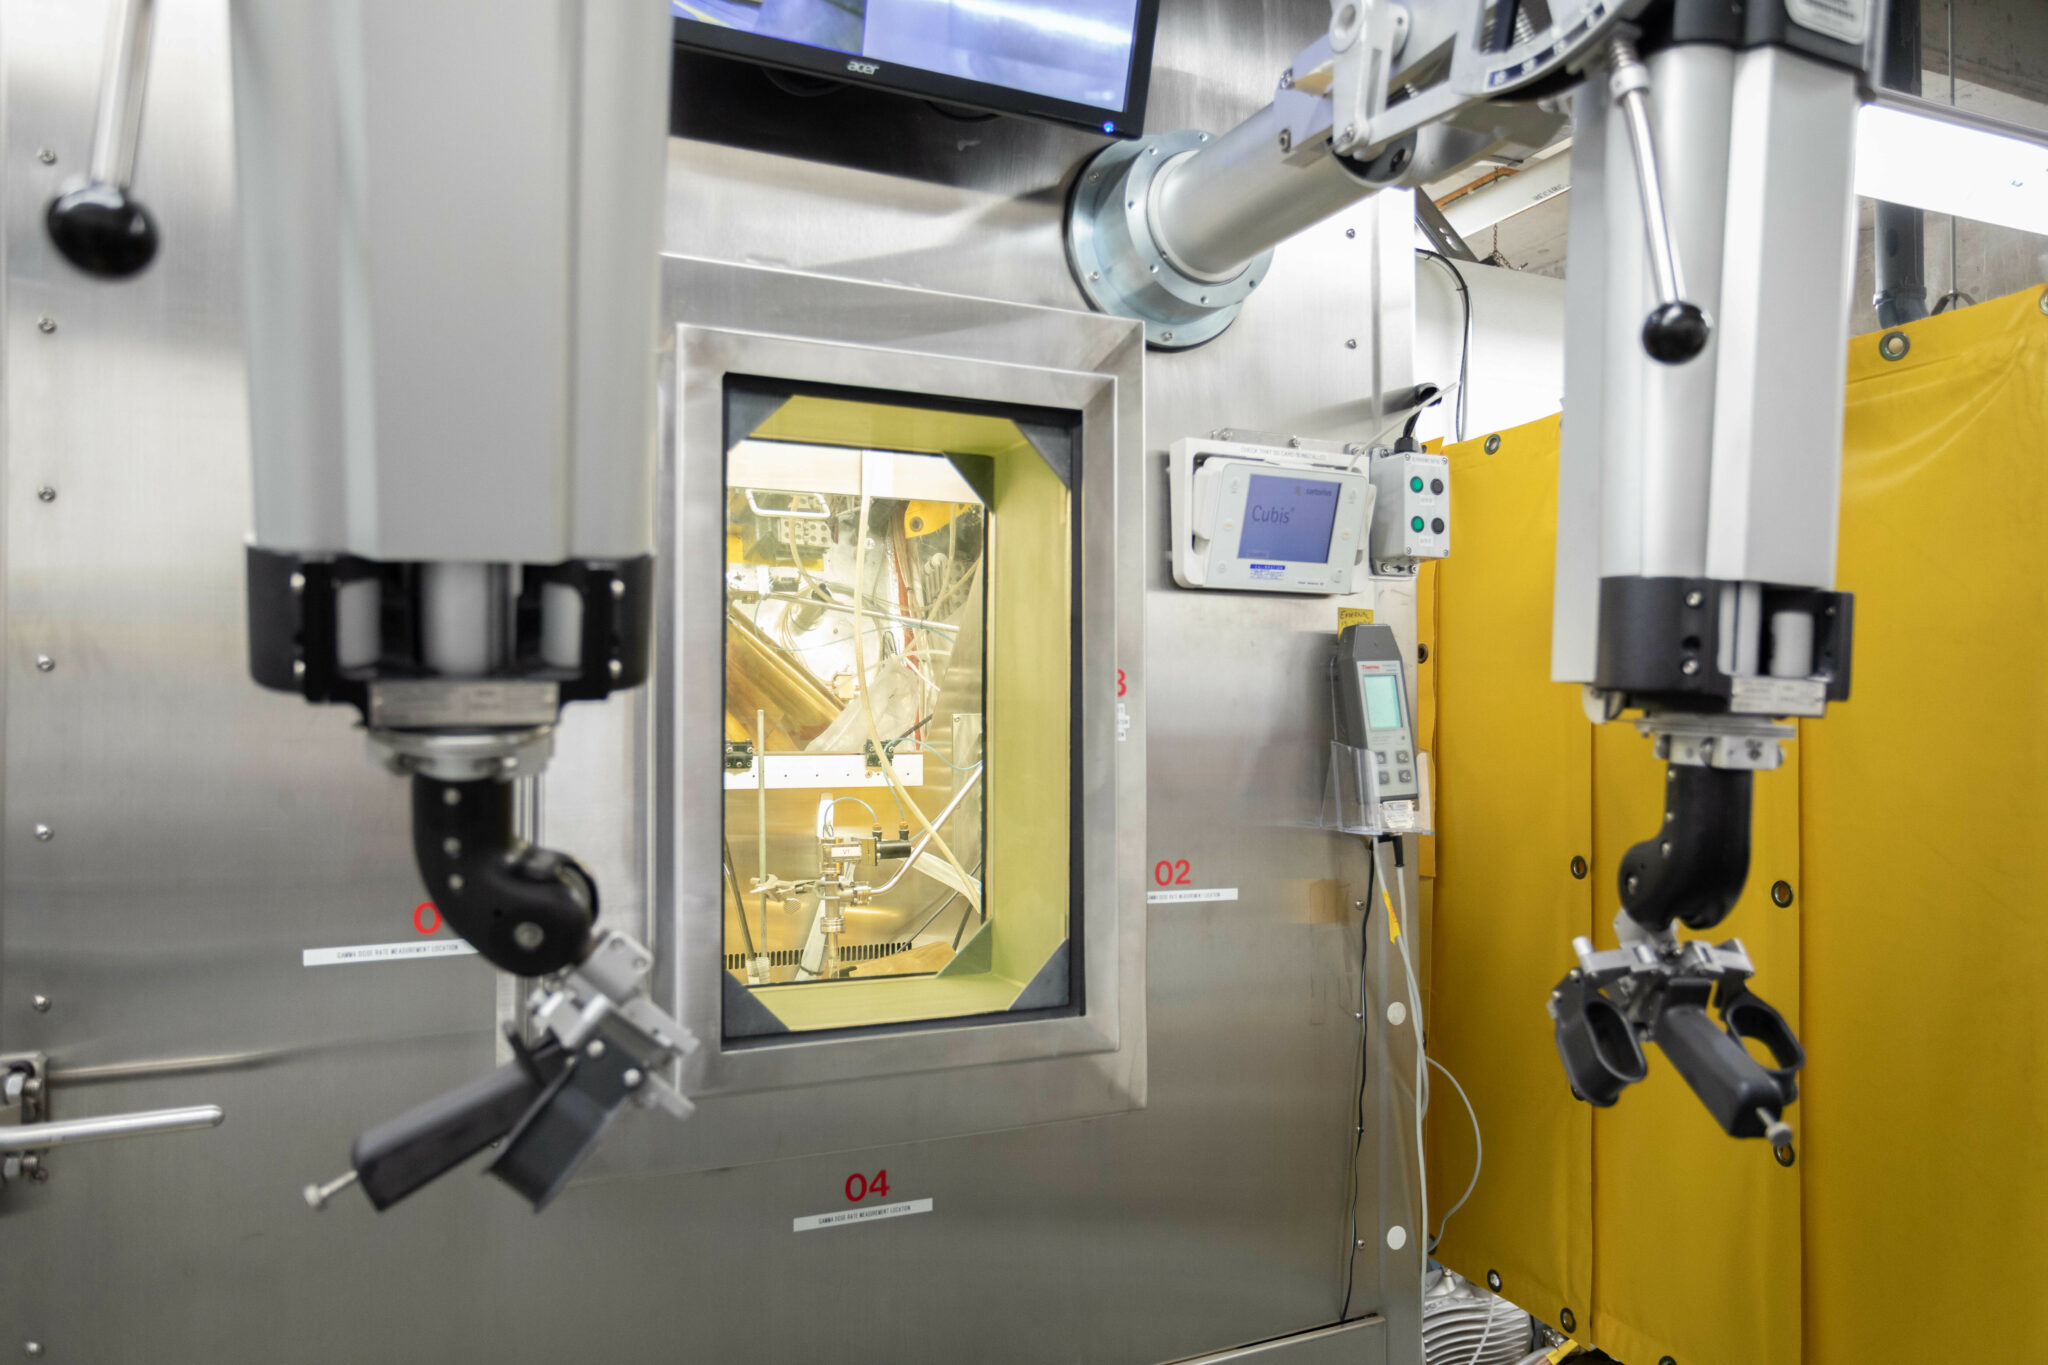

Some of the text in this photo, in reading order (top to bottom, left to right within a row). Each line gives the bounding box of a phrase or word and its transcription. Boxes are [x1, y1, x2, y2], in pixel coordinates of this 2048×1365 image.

[847, 61, 880, 75] acer
[1305, 488, 1332, 497] sartorius
[1117, 669, 1127, 696] 3
[1155, 859, 1191, 886] 02
[413, 902, 443, 934] 0
[336, 951, 357, 959] GAMMA
[358, 950, 373, 958] DOSE
[391, 946, 429, 955] MEASUREMENT
[431, 944, 459, 952] LOCATION
[845, 1169, 891, 1202] 04
[818, 1217, 834, 1225] GAMMA
[859, 1207, 889, 1218] MEASUREMENT
[890, 1204, 911, 1214] LOCATION
